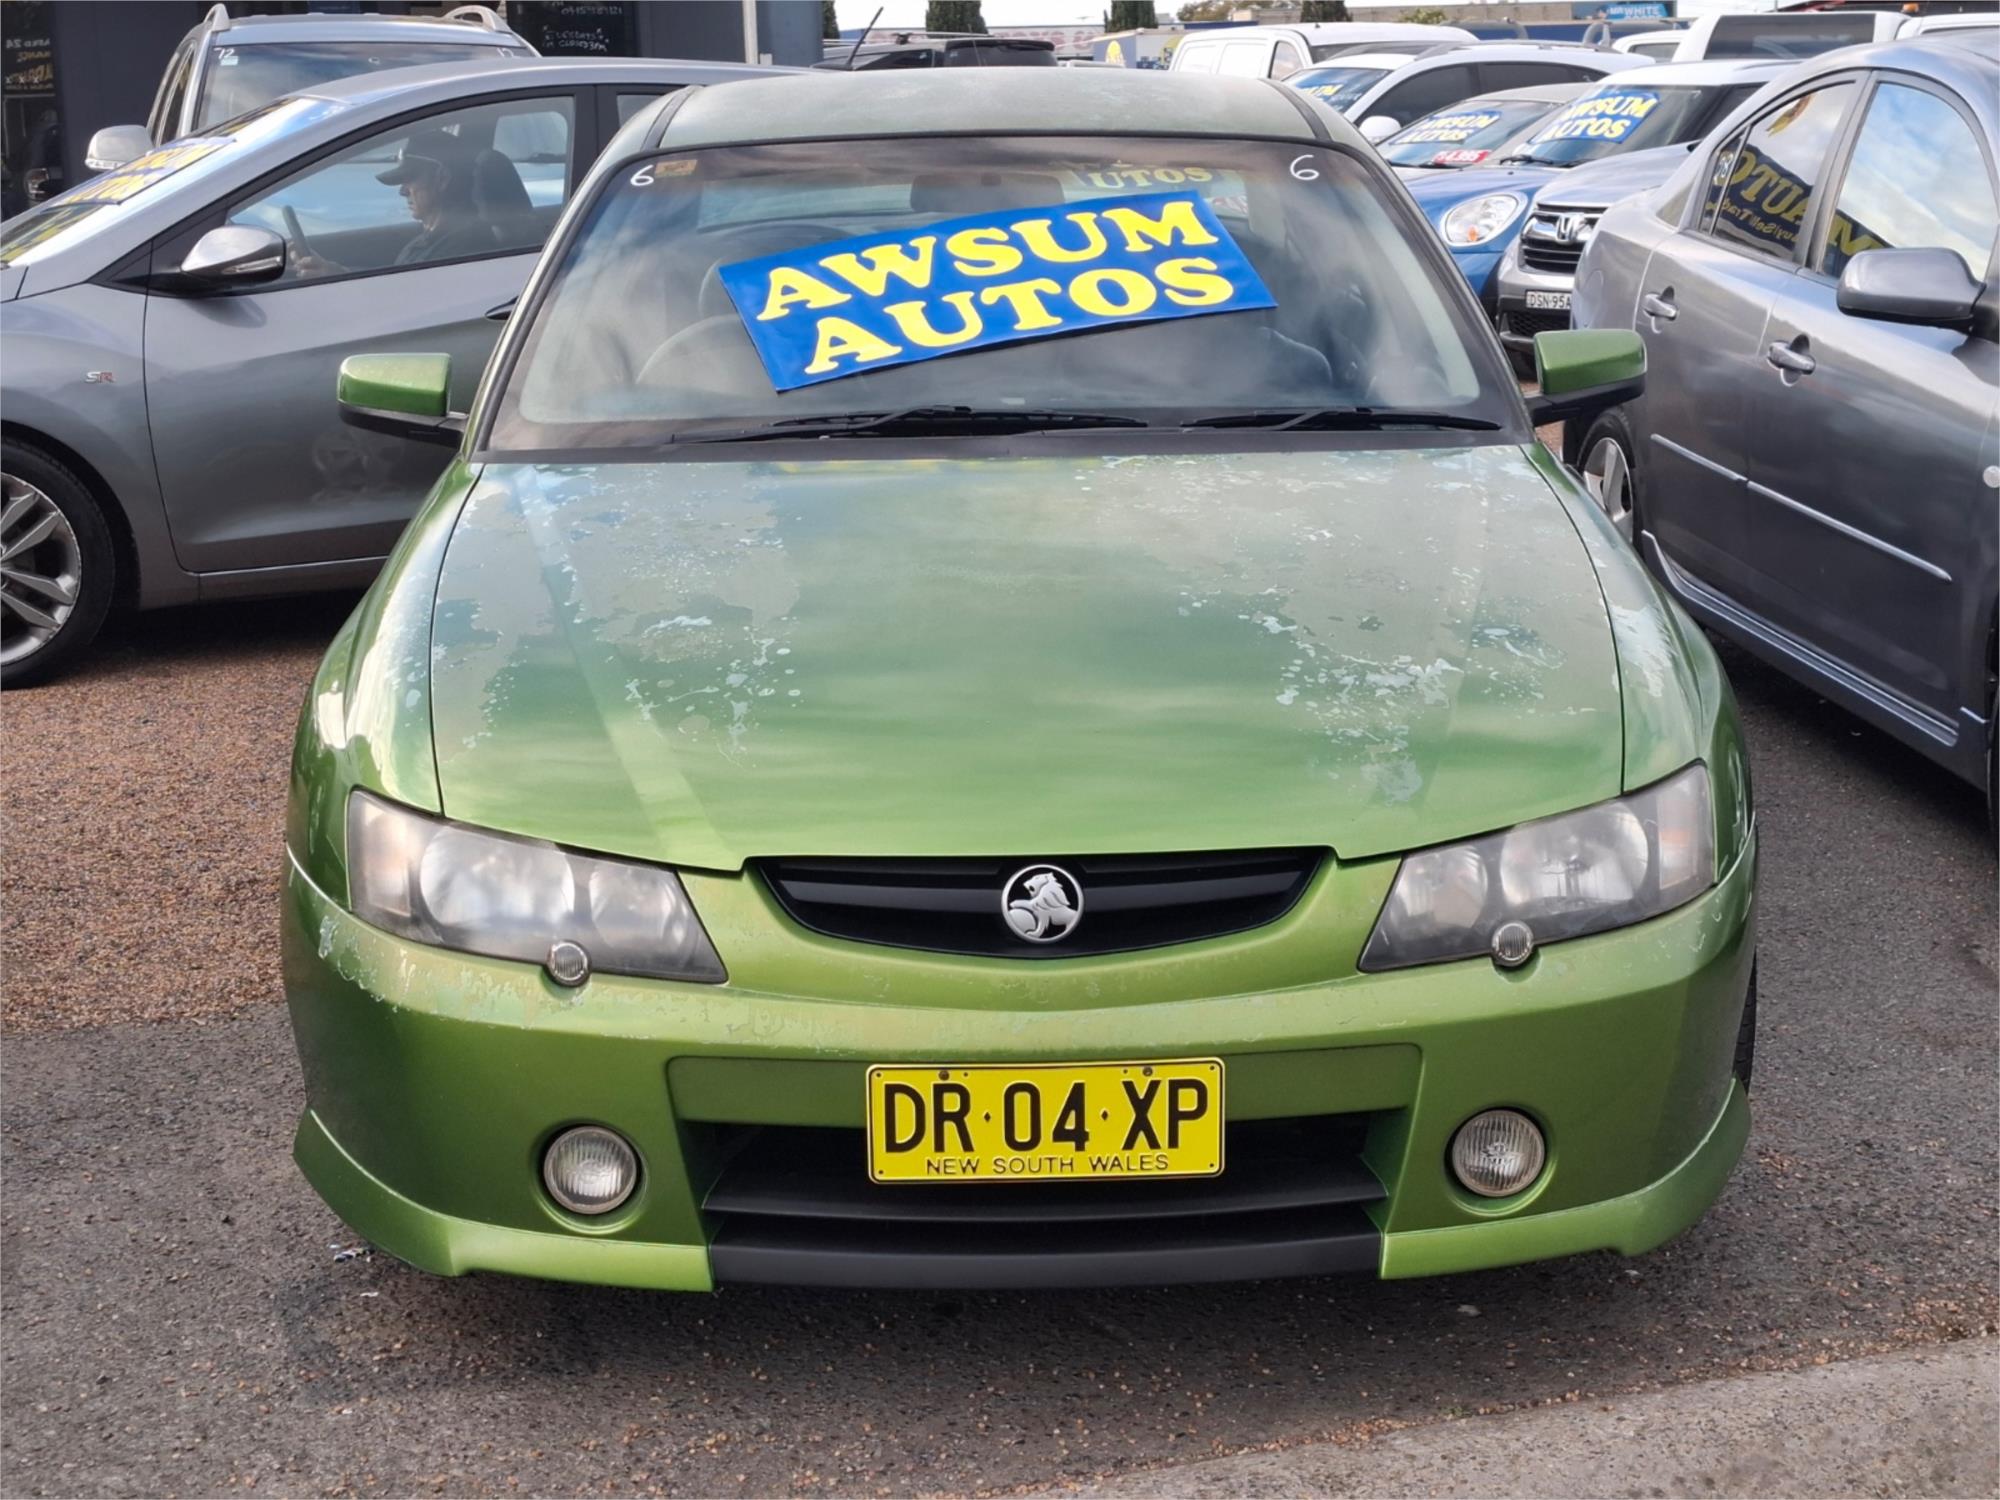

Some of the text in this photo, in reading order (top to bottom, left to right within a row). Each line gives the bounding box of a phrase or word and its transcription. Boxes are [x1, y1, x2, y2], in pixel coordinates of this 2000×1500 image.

[1624, 6, 1660, 16] WHITE
[630, 164, 654, 186] 6
[1290, 154, 1320, 181] 6
[756, 202, 1219, 321] AWSUM
[804, 257, 1234, 374] AUTOS
[85, 371, 115, 384] SR
[926, 1153, 1169, 1175] NEW SOUTH WALES
